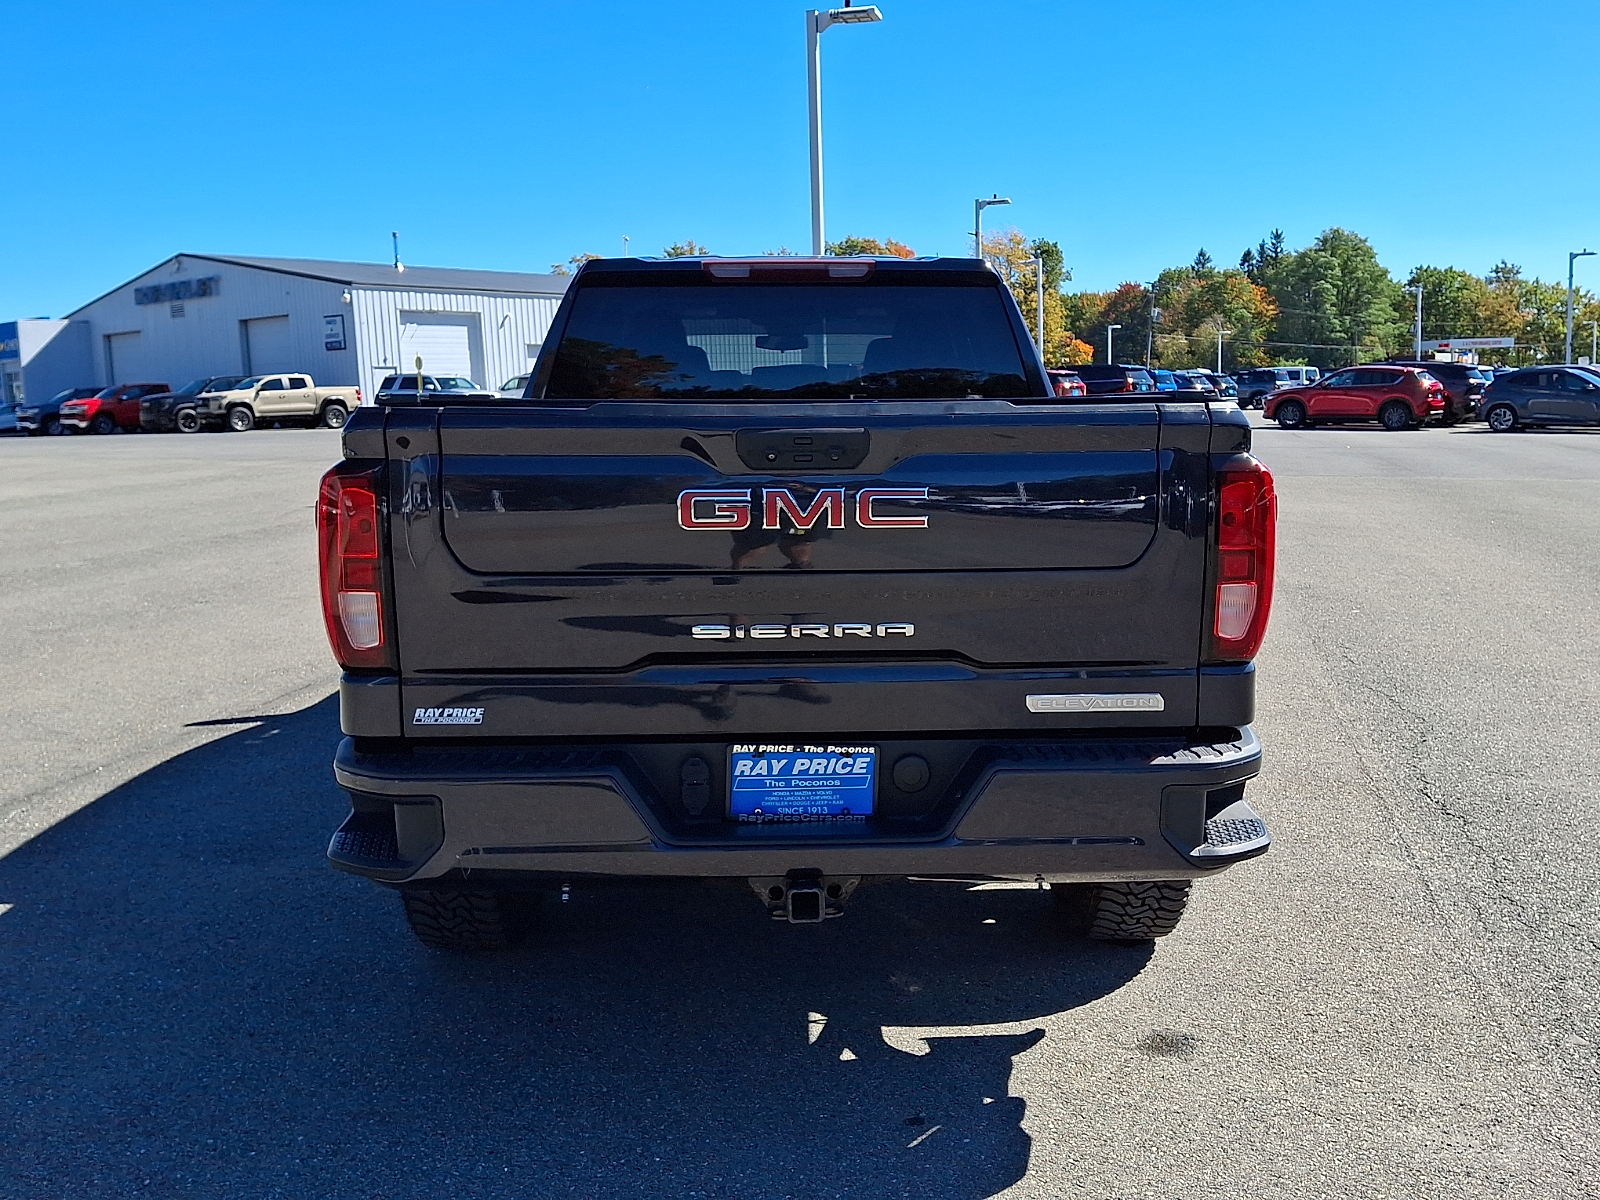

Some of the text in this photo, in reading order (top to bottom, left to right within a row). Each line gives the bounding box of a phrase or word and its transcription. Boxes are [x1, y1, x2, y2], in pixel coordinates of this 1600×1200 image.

[677, 487, 929, 531] GMC
[692, 622, 915, 639] SIERRA
[1037, 697, 1154, 710] ELEVATION
[415, 708, 485, 717] RAY PRICE
[732, 745, 756, 753] RAY
[759, 745, 794, 753] PRICE
[804, 745, 825, 753] The
[827, 745, 875, 754] Poconos
[734, 757, 871, 776] RAY PRICE
[764, 779, 841, 787] The Poconos
[807, 806, 828, 814] 1913
[738, 813, 866, 823] RayPriceCars.com
